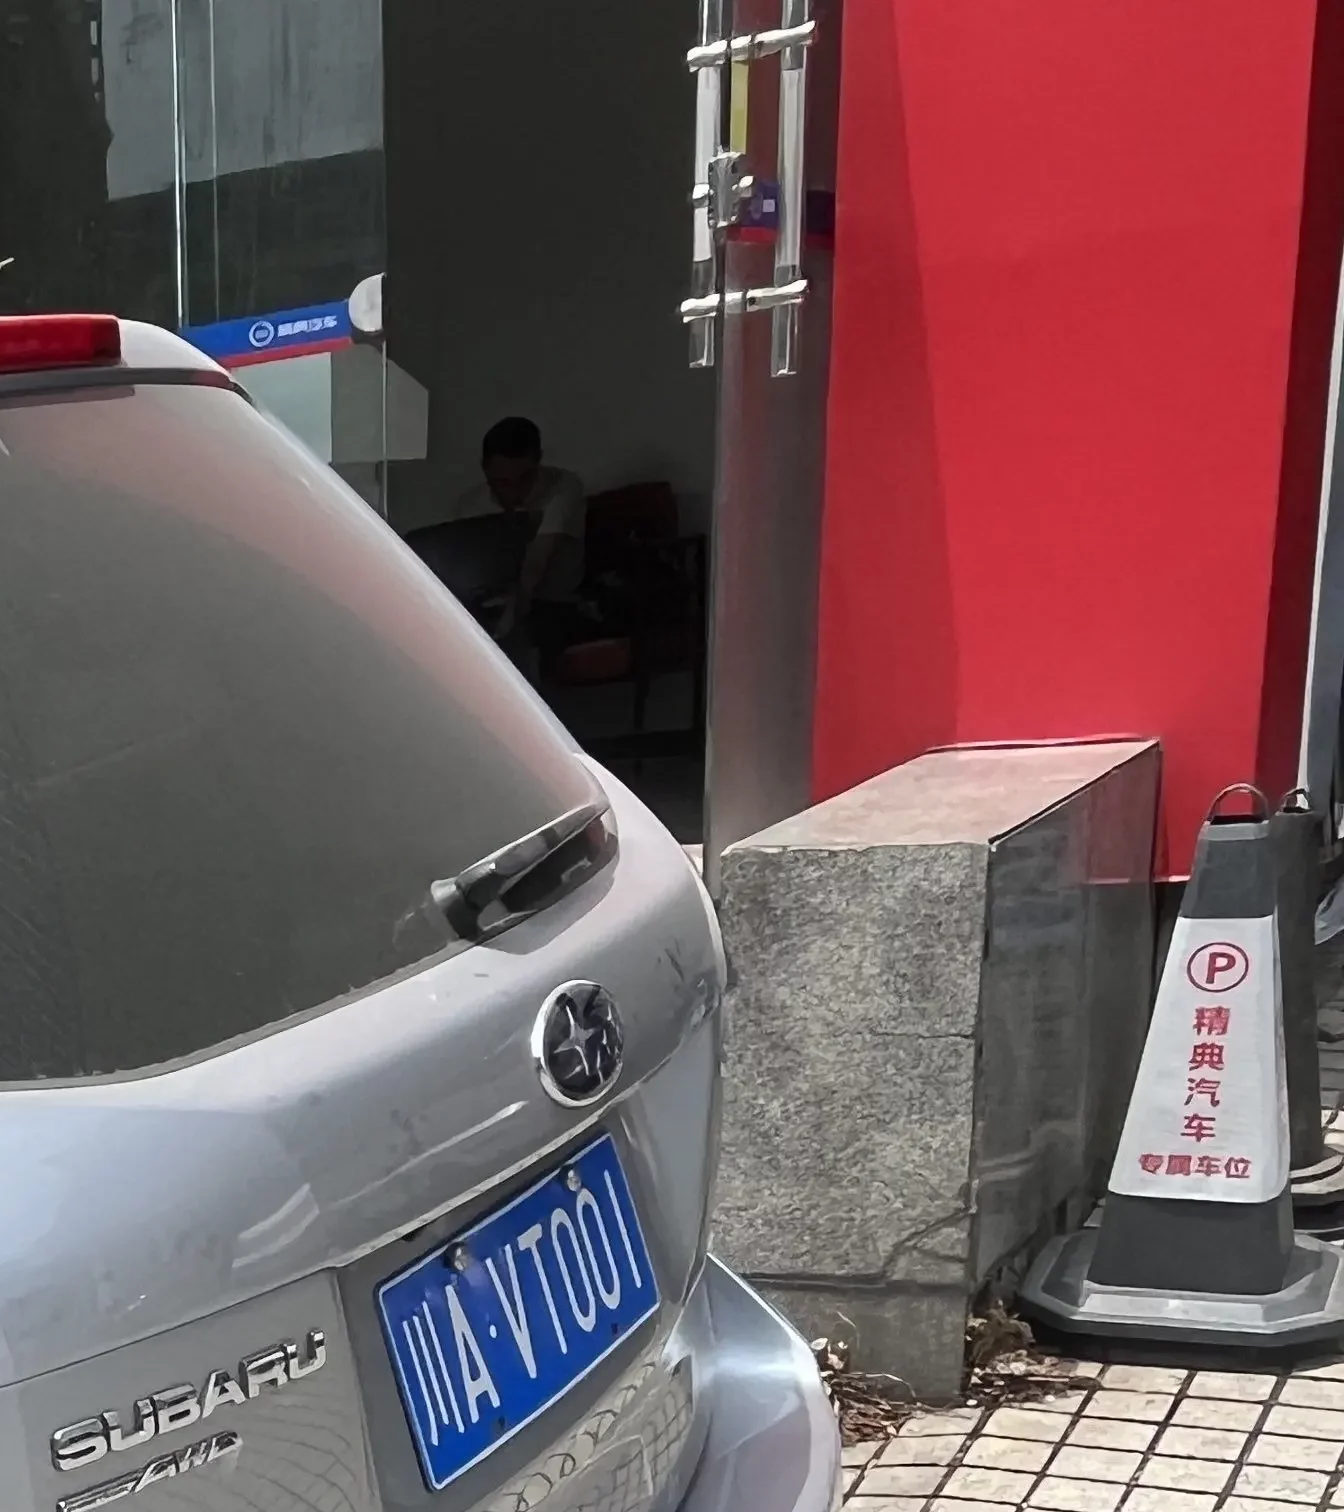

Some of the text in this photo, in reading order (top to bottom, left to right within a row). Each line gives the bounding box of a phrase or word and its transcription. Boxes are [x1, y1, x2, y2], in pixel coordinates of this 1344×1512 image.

[1205, 951, 1237, 985] P
[1180, 1005, 1231, 1143] 精典汽车
[50, 1328, 327, 1472] SUBARU
